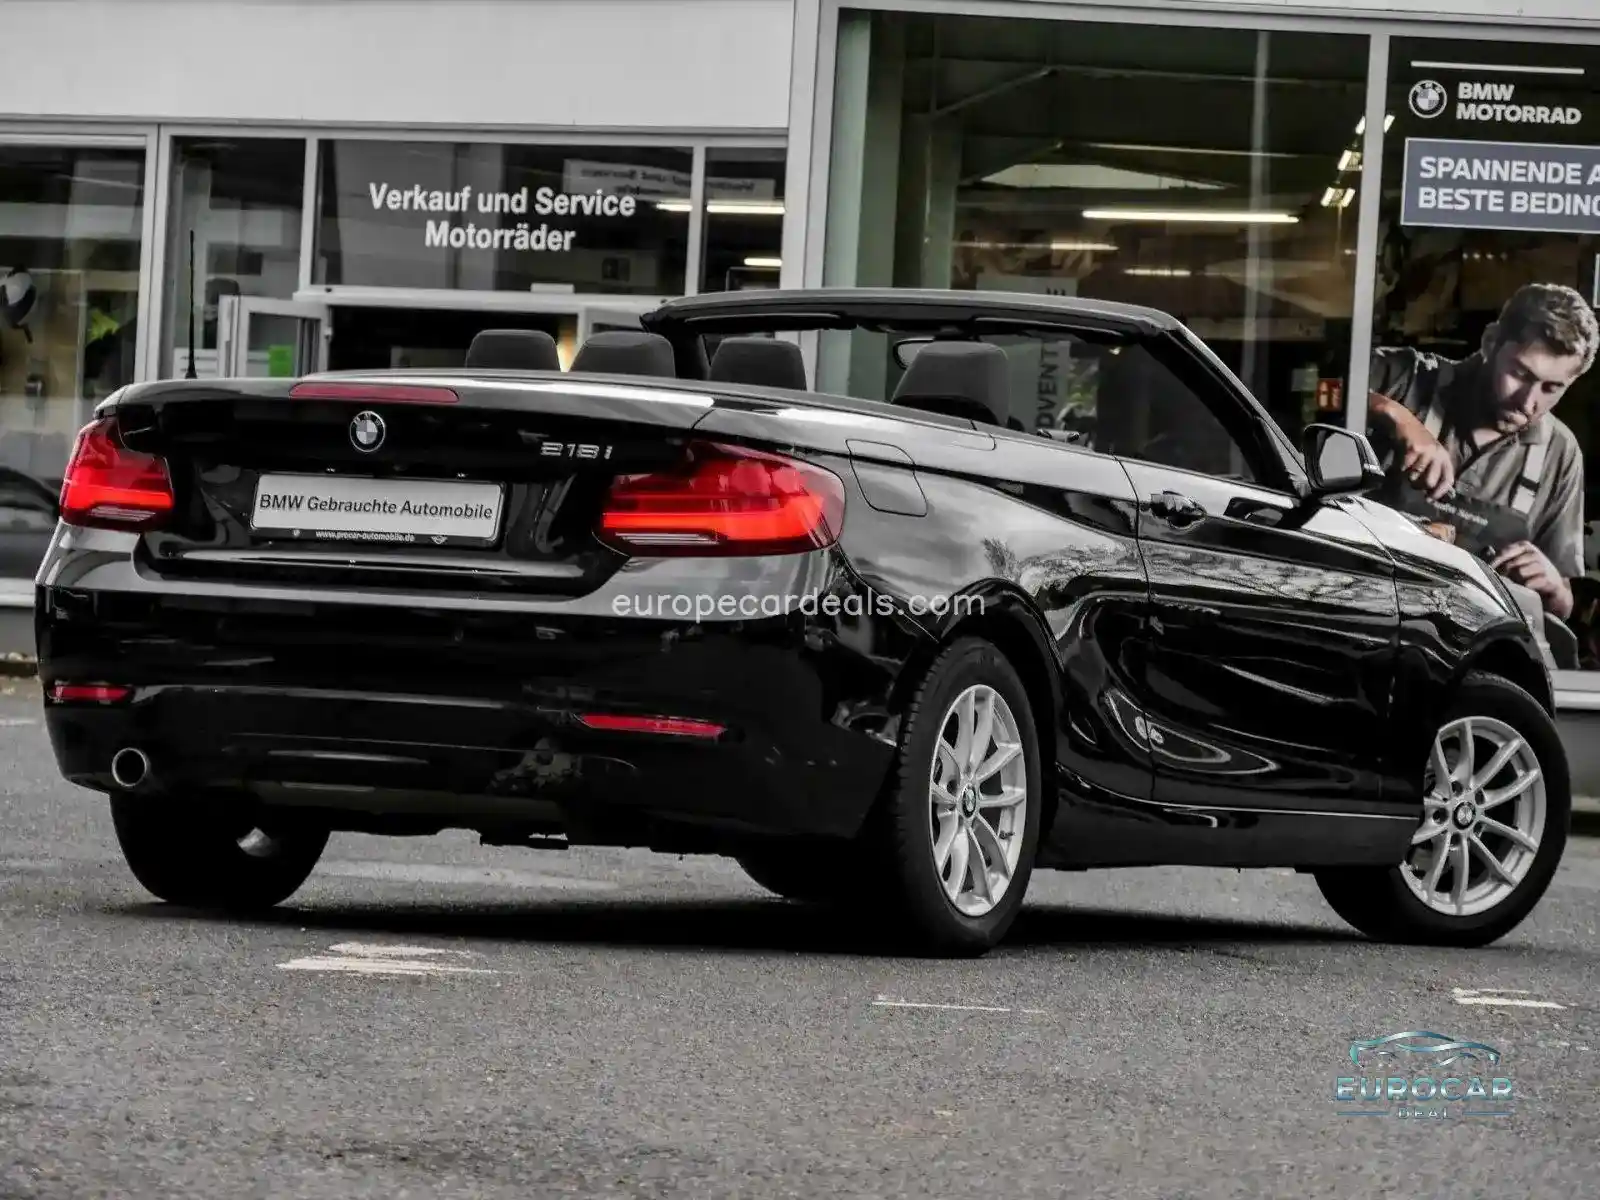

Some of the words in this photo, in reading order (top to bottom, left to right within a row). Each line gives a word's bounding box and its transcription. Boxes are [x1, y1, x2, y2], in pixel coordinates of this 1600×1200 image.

[1458, 82, 1515, 101] BMW
[1456, 103, 1582, 125] MOTORRAD
[1420, 156, 1582, 185] SPANNENDE
[369, 182, 472, 212] Verkauf
[477, 186, 528, 214] und
[535, 186, 636, 217] Service
[1418, 187, 1504, 212] BESTE
[425, 219, 576, 251] Motorräder
[259, 494, 304, 511] BMW
[307, 496, 397, 515] Gebrauchte
[401, 499, 493, 520] Automobile
